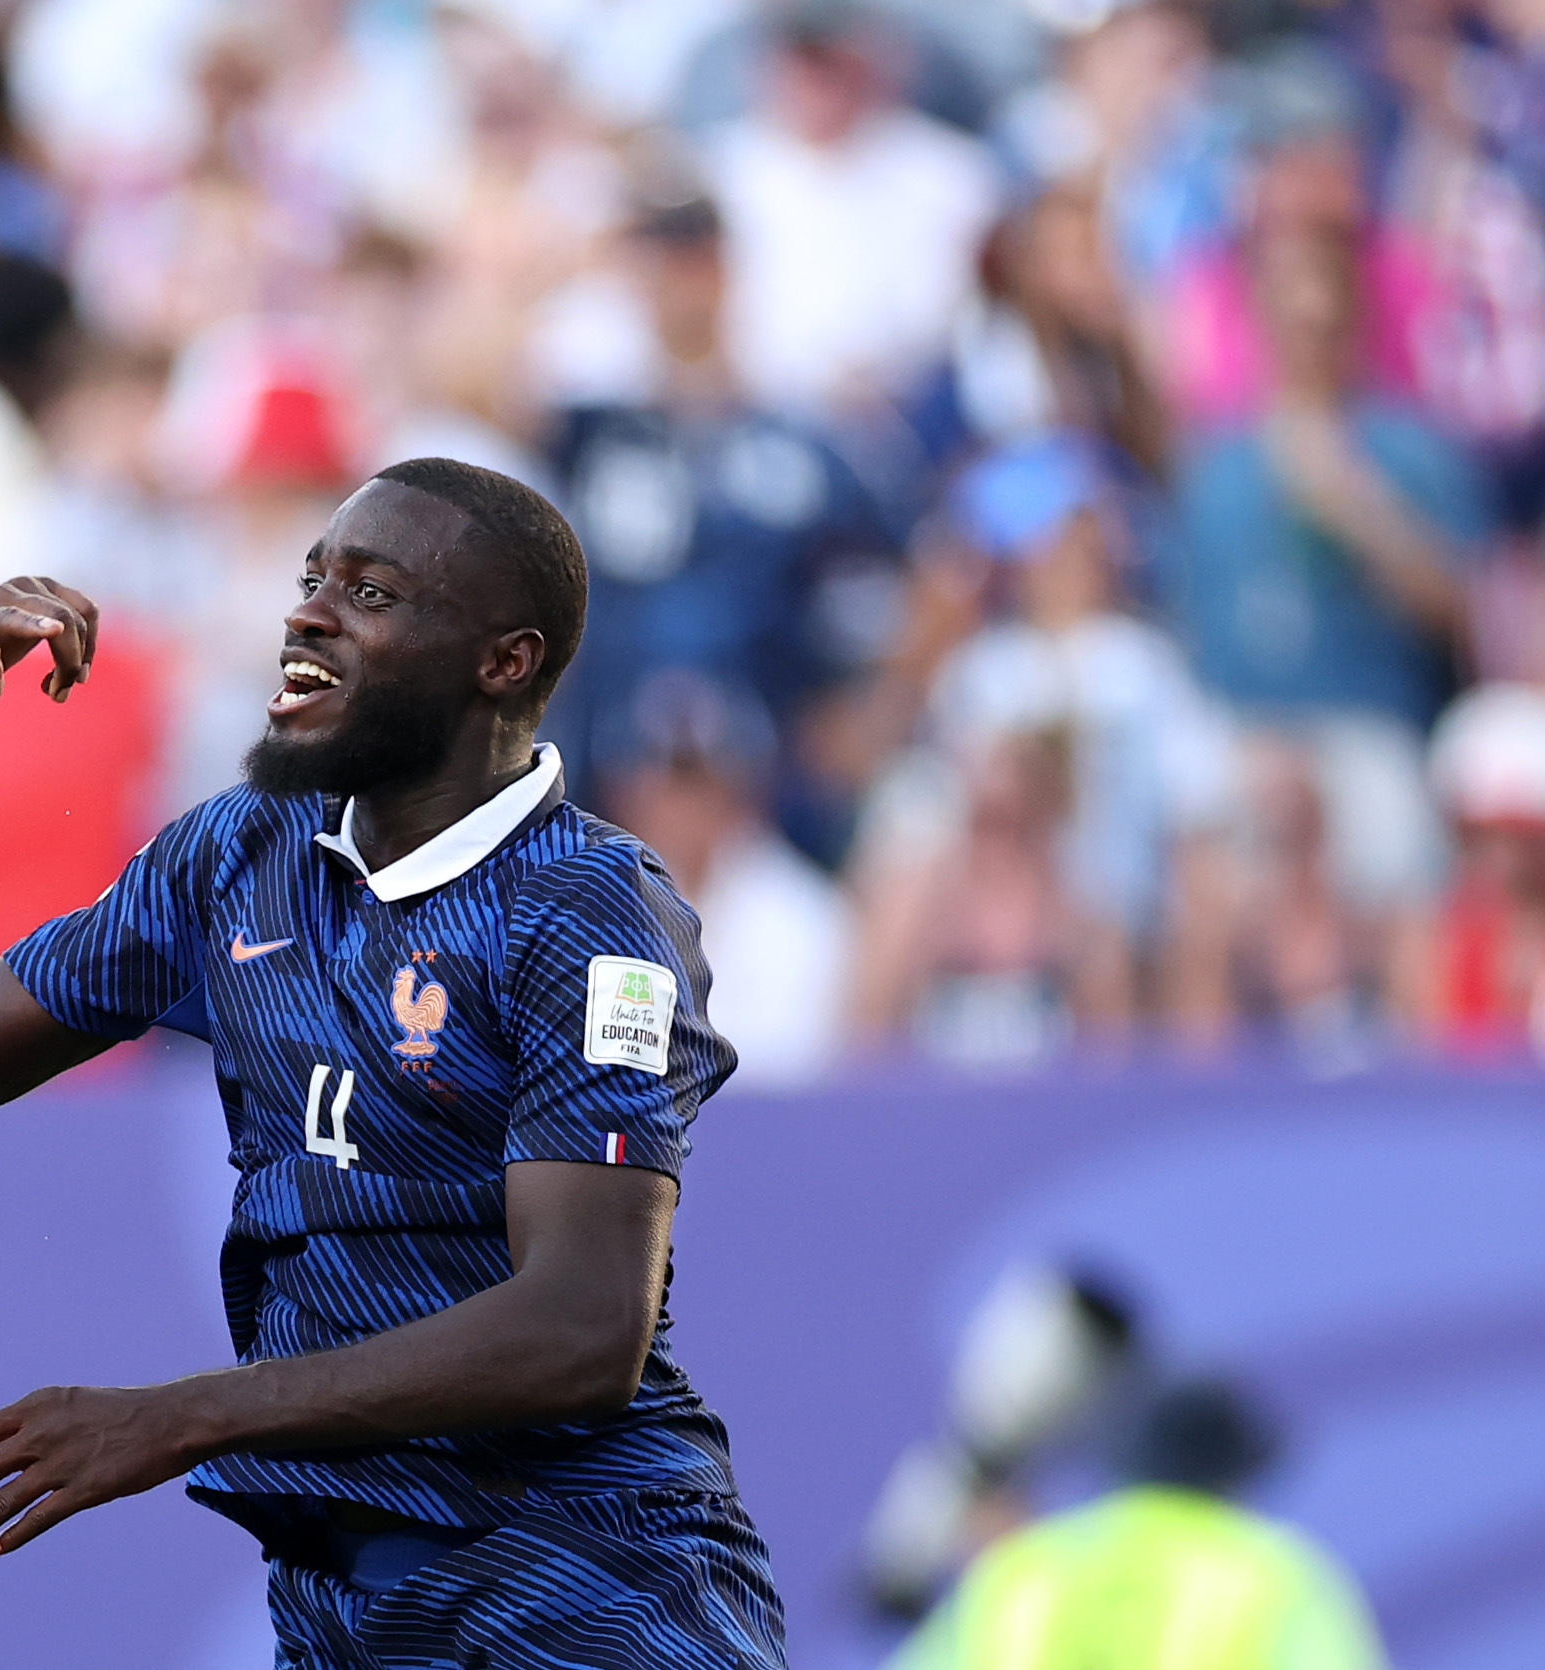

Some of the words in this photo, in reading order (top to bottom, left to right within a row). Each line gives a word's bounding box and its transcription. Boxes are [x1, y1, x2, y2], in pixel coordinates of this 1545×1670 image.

[602, 1024, 660, 1048] EDUCATION
[620, 1044, 641, 1055] FIFA
[401, 1061, 432, 1073] FFF
[305, 1064, 360, 1169] 4
